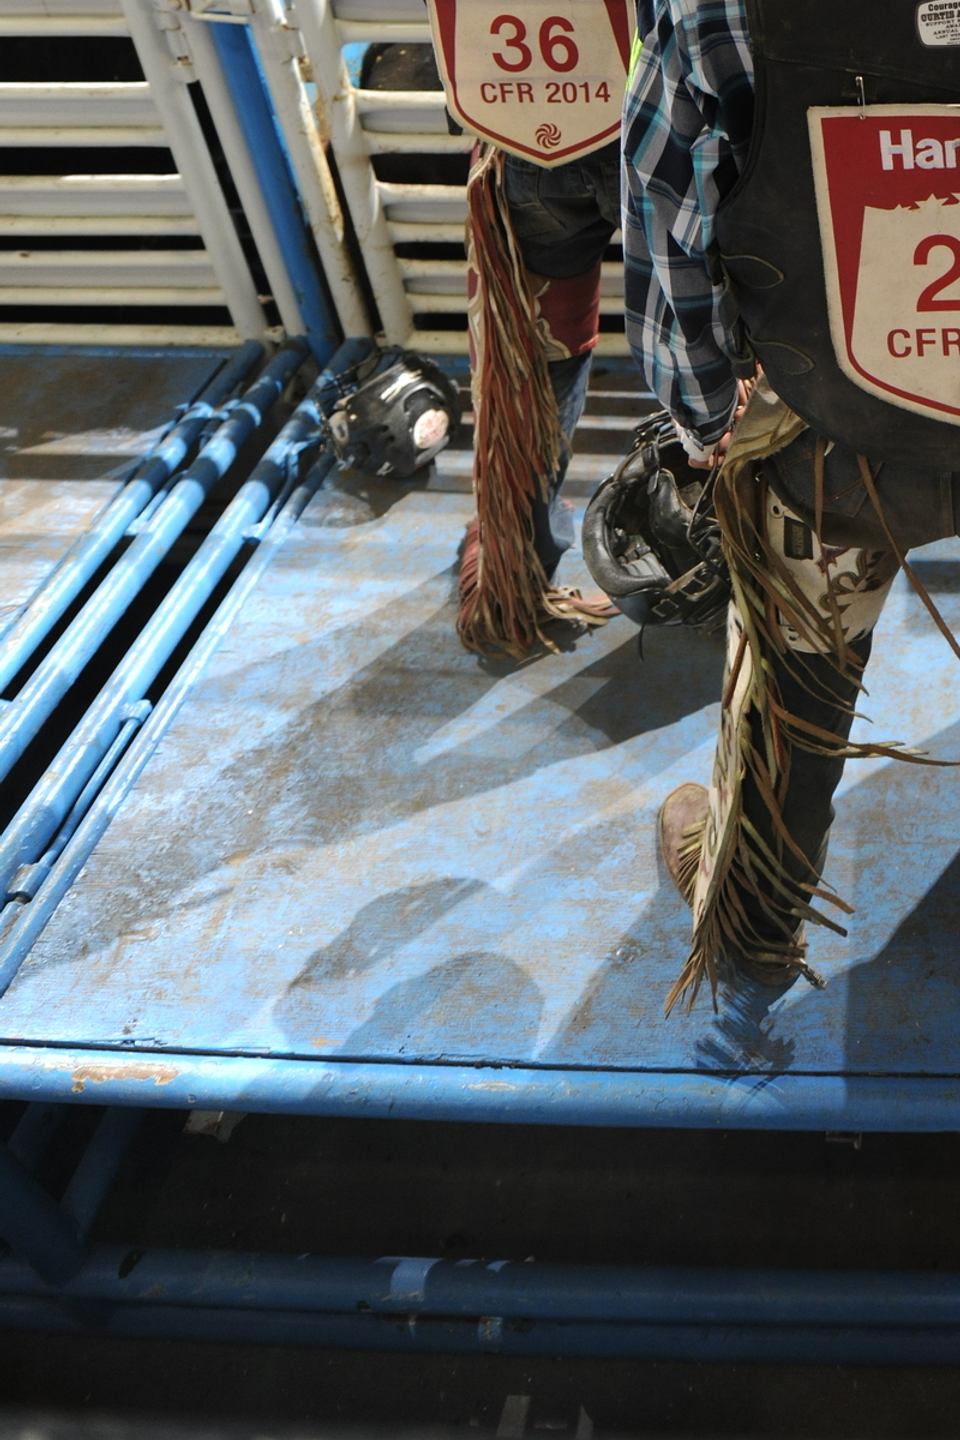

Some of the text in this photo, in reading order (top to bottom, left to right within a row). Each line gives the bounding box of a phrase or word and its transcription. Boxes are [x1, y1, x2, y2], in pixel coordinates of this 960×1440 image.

[921, 10, 955, 22] CURTIS
[490, 15, 579, 73] 36
[480, 81, 611, 104] CFR 2014
